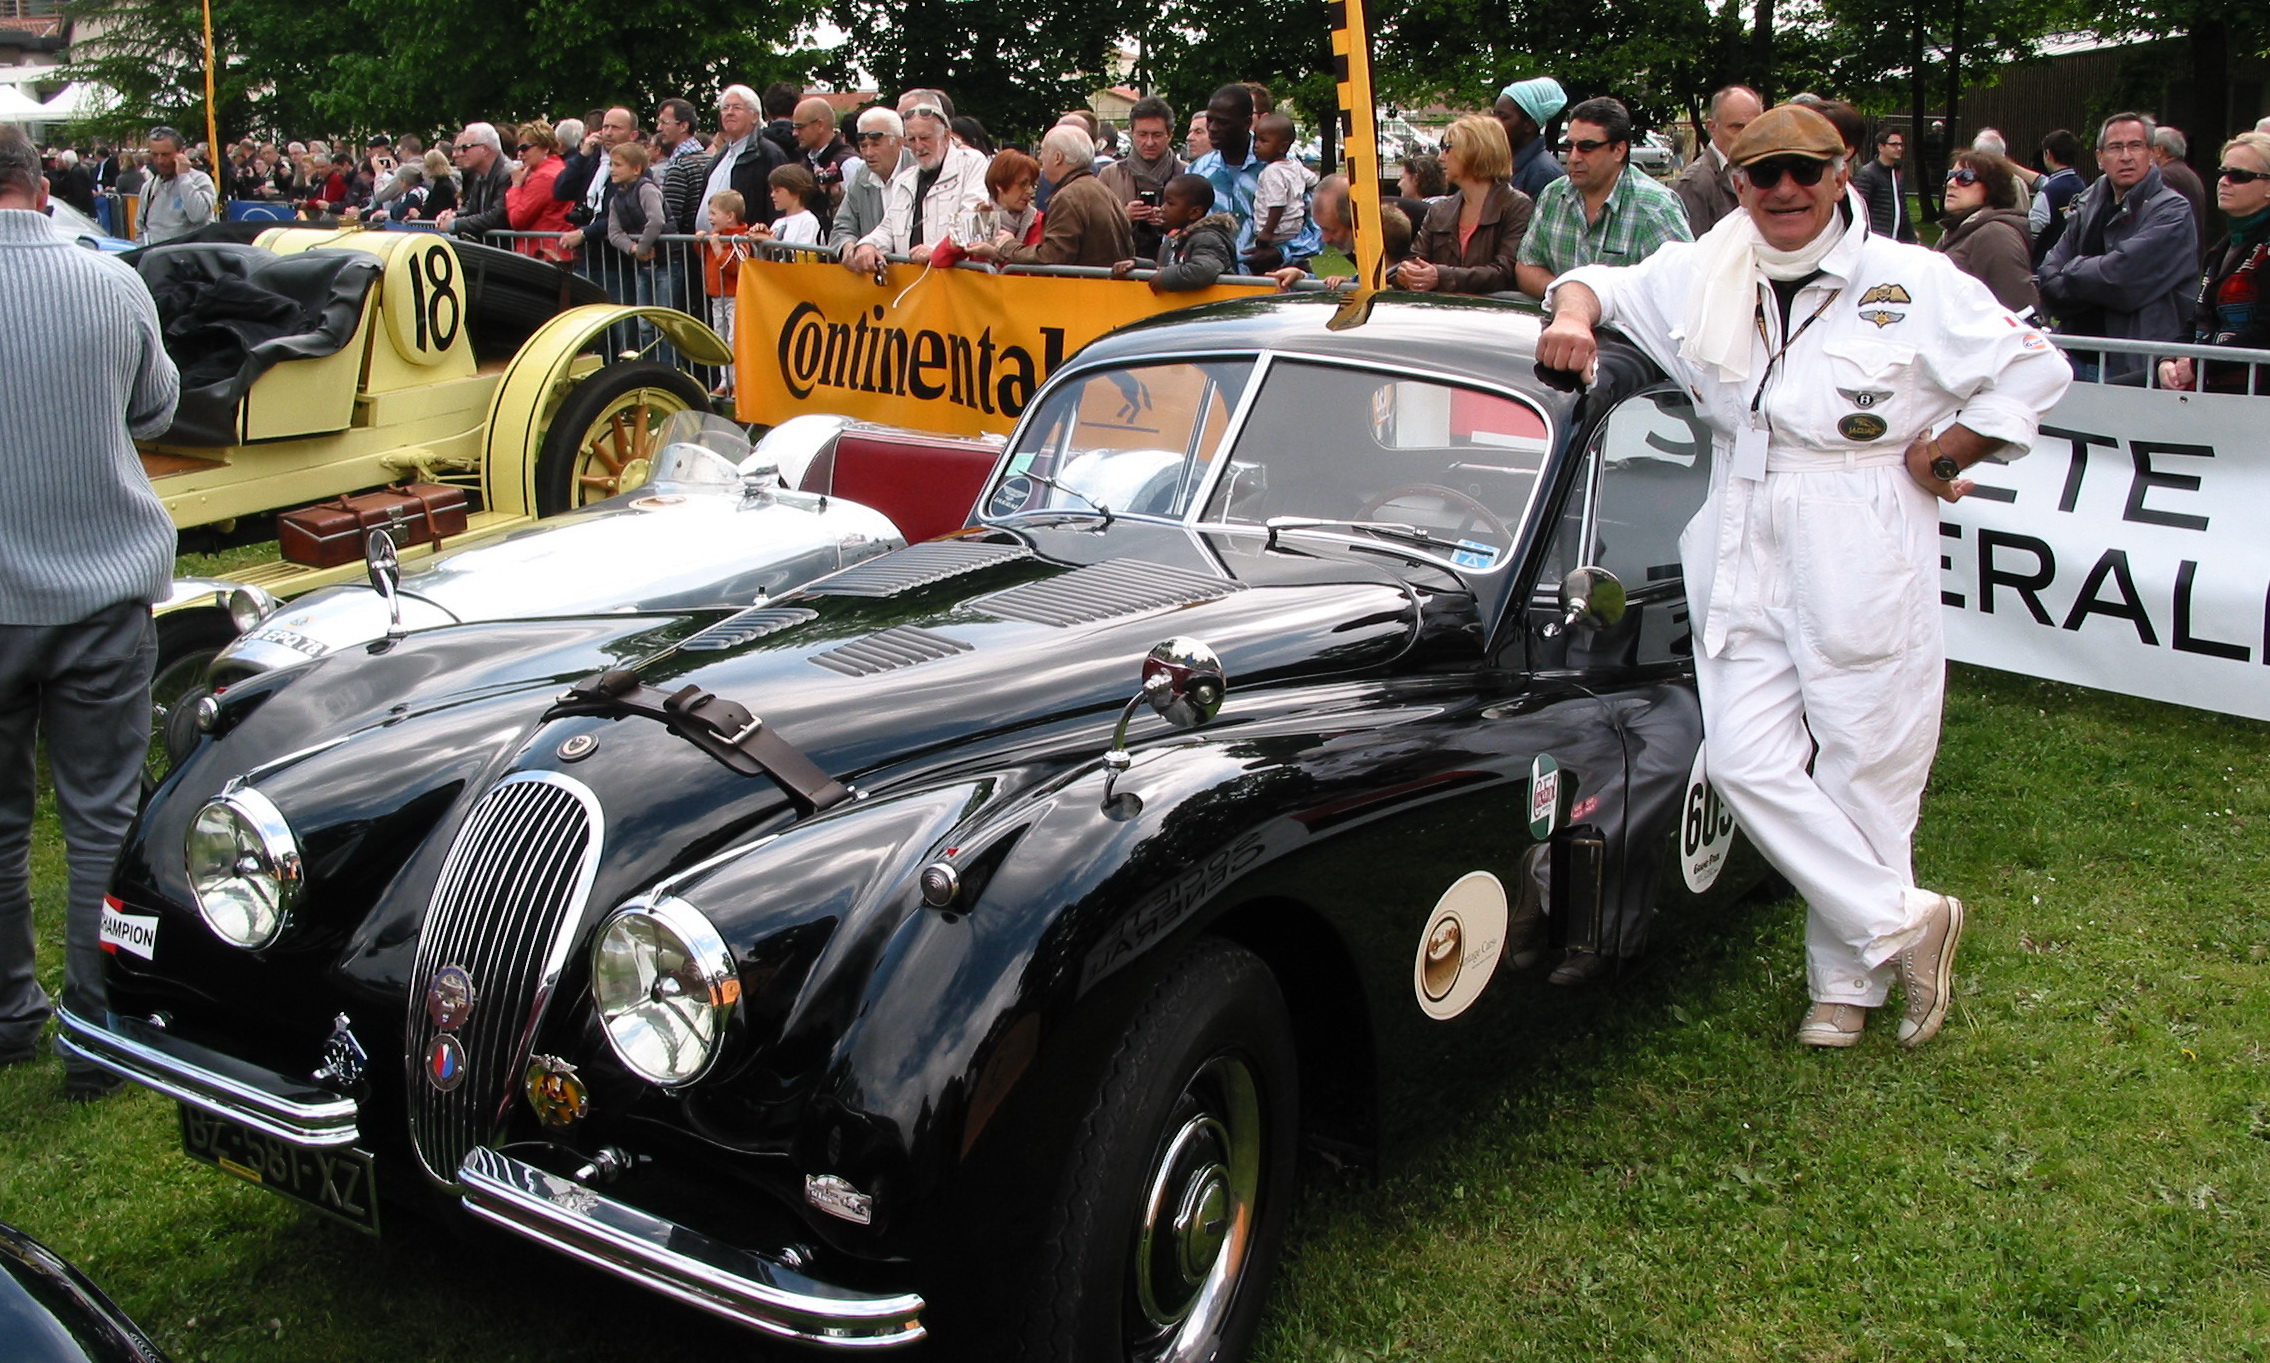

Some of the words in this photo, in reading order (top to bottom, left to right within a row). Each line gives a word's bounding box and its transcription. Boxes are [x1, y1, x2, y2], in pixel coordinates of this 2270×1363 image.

[408, 244, 460, 354] 18
[777, 301, 1065, 418] Continental
[298, 638, 325, 656] 78
[1938, 521, 2270, 666] RAL
